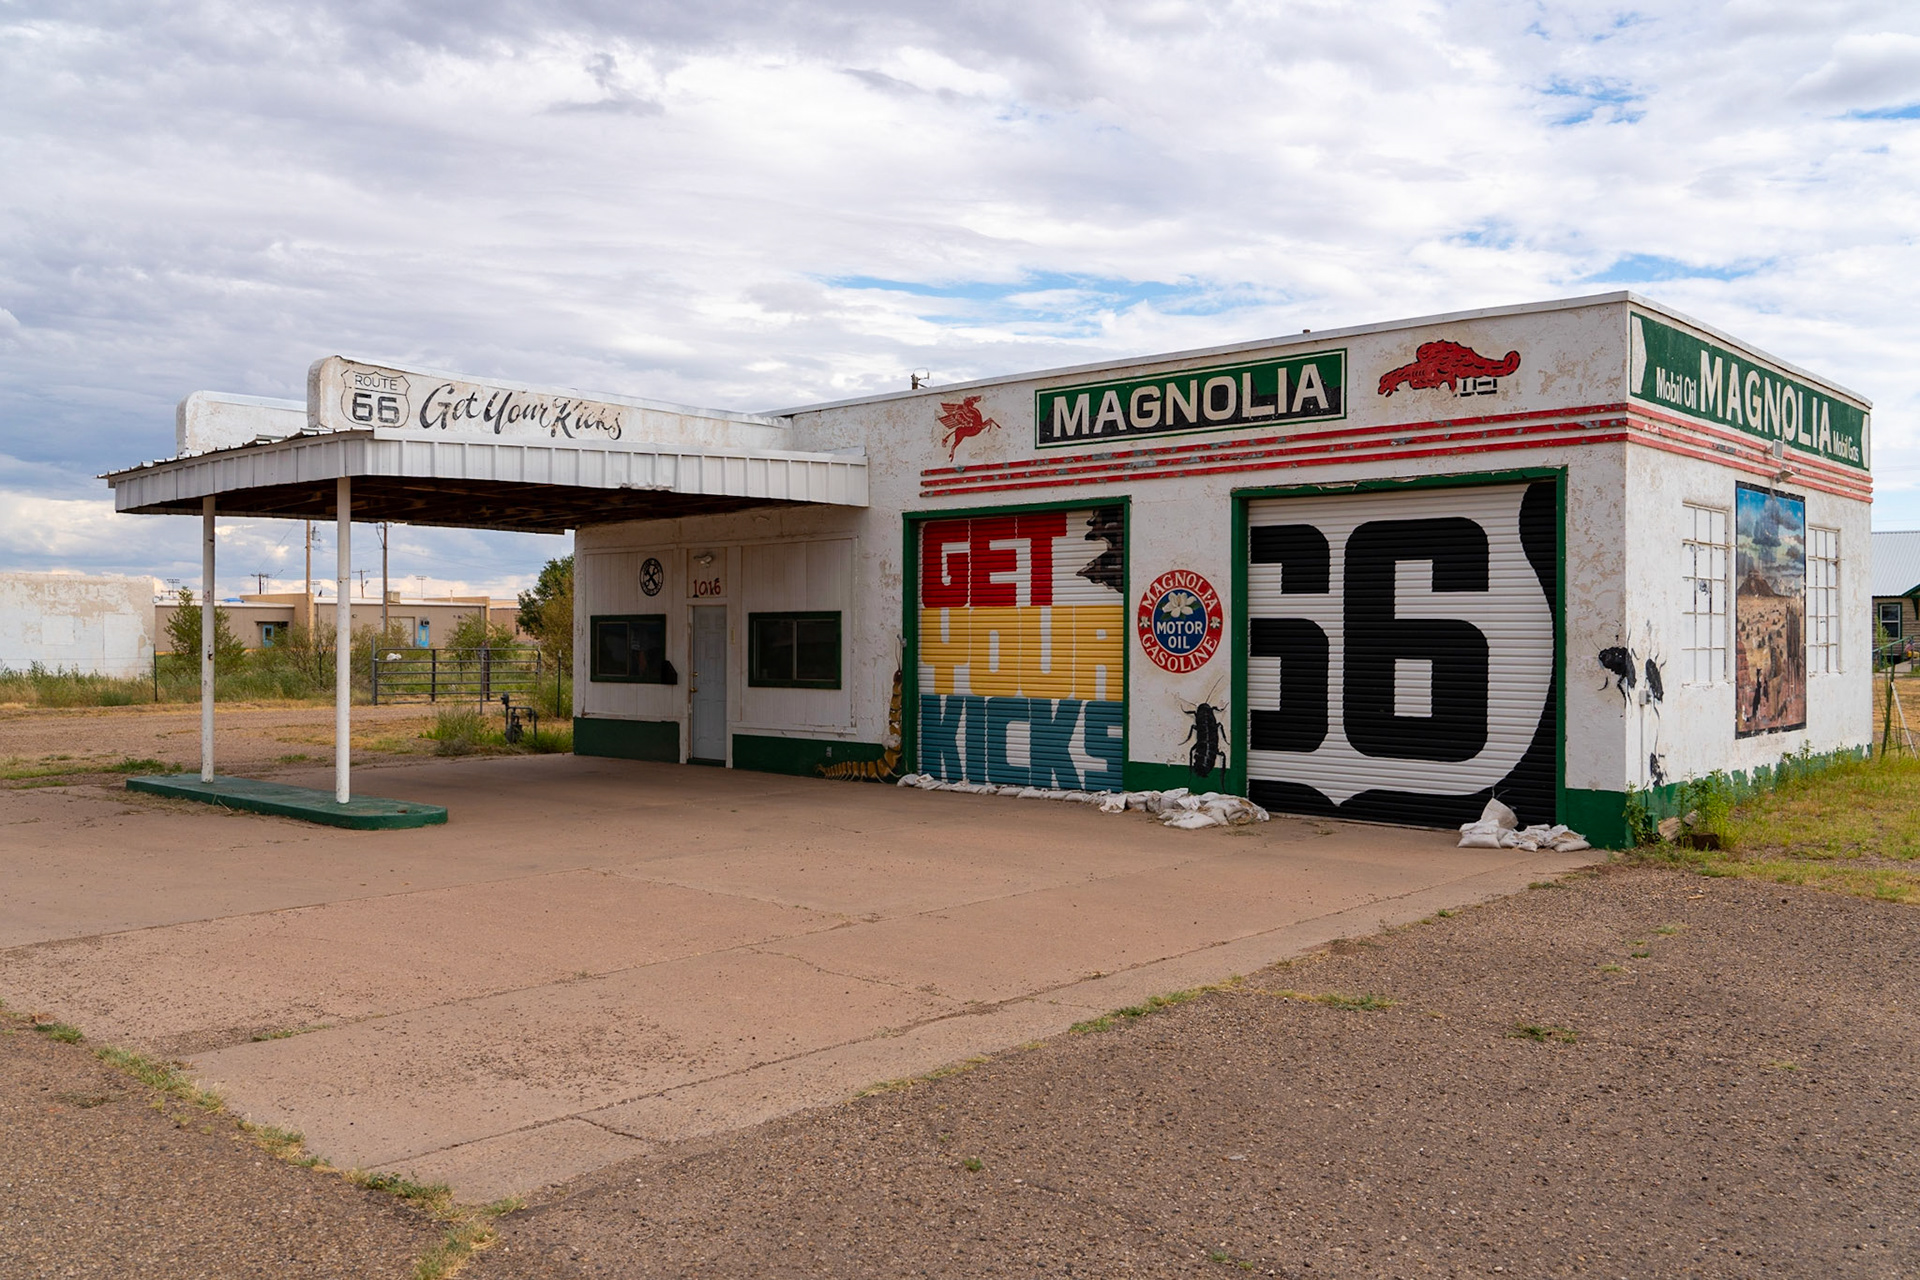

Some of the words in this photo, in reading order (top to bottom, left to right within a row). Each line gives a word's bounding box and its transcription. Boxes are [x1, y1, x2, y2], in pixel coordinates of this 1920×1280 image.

[354, 374, 398, 391] ROUTE
[1052, 363, 1330, 438] MAGNOLIA
[1656, 366, 1682, 405] Mobil
[1684, 376, 1697, 410] Oil
[1701, 349, 1833, 454] MAGNOLIA
[352, 392, 400, 424] 66
[420, 383, 481, 430] Get
[483, 391, 551, 435] Your
[551, 397, 622, 440] Kicks
[921, 512, 1067, 608] GET
[692, 577, 722, 598] 1016
[1141, 571, 1219, 613] MAGNOLIA
[1156, 621, 1204, 635] MOTOR
[1167, 636, 1191, 649] OIL
[921, 605, 1124, 701] YOUR
[1141, 633, 1219, 672] GASOLINE
[921, 694, 1124, 793] KICKS
